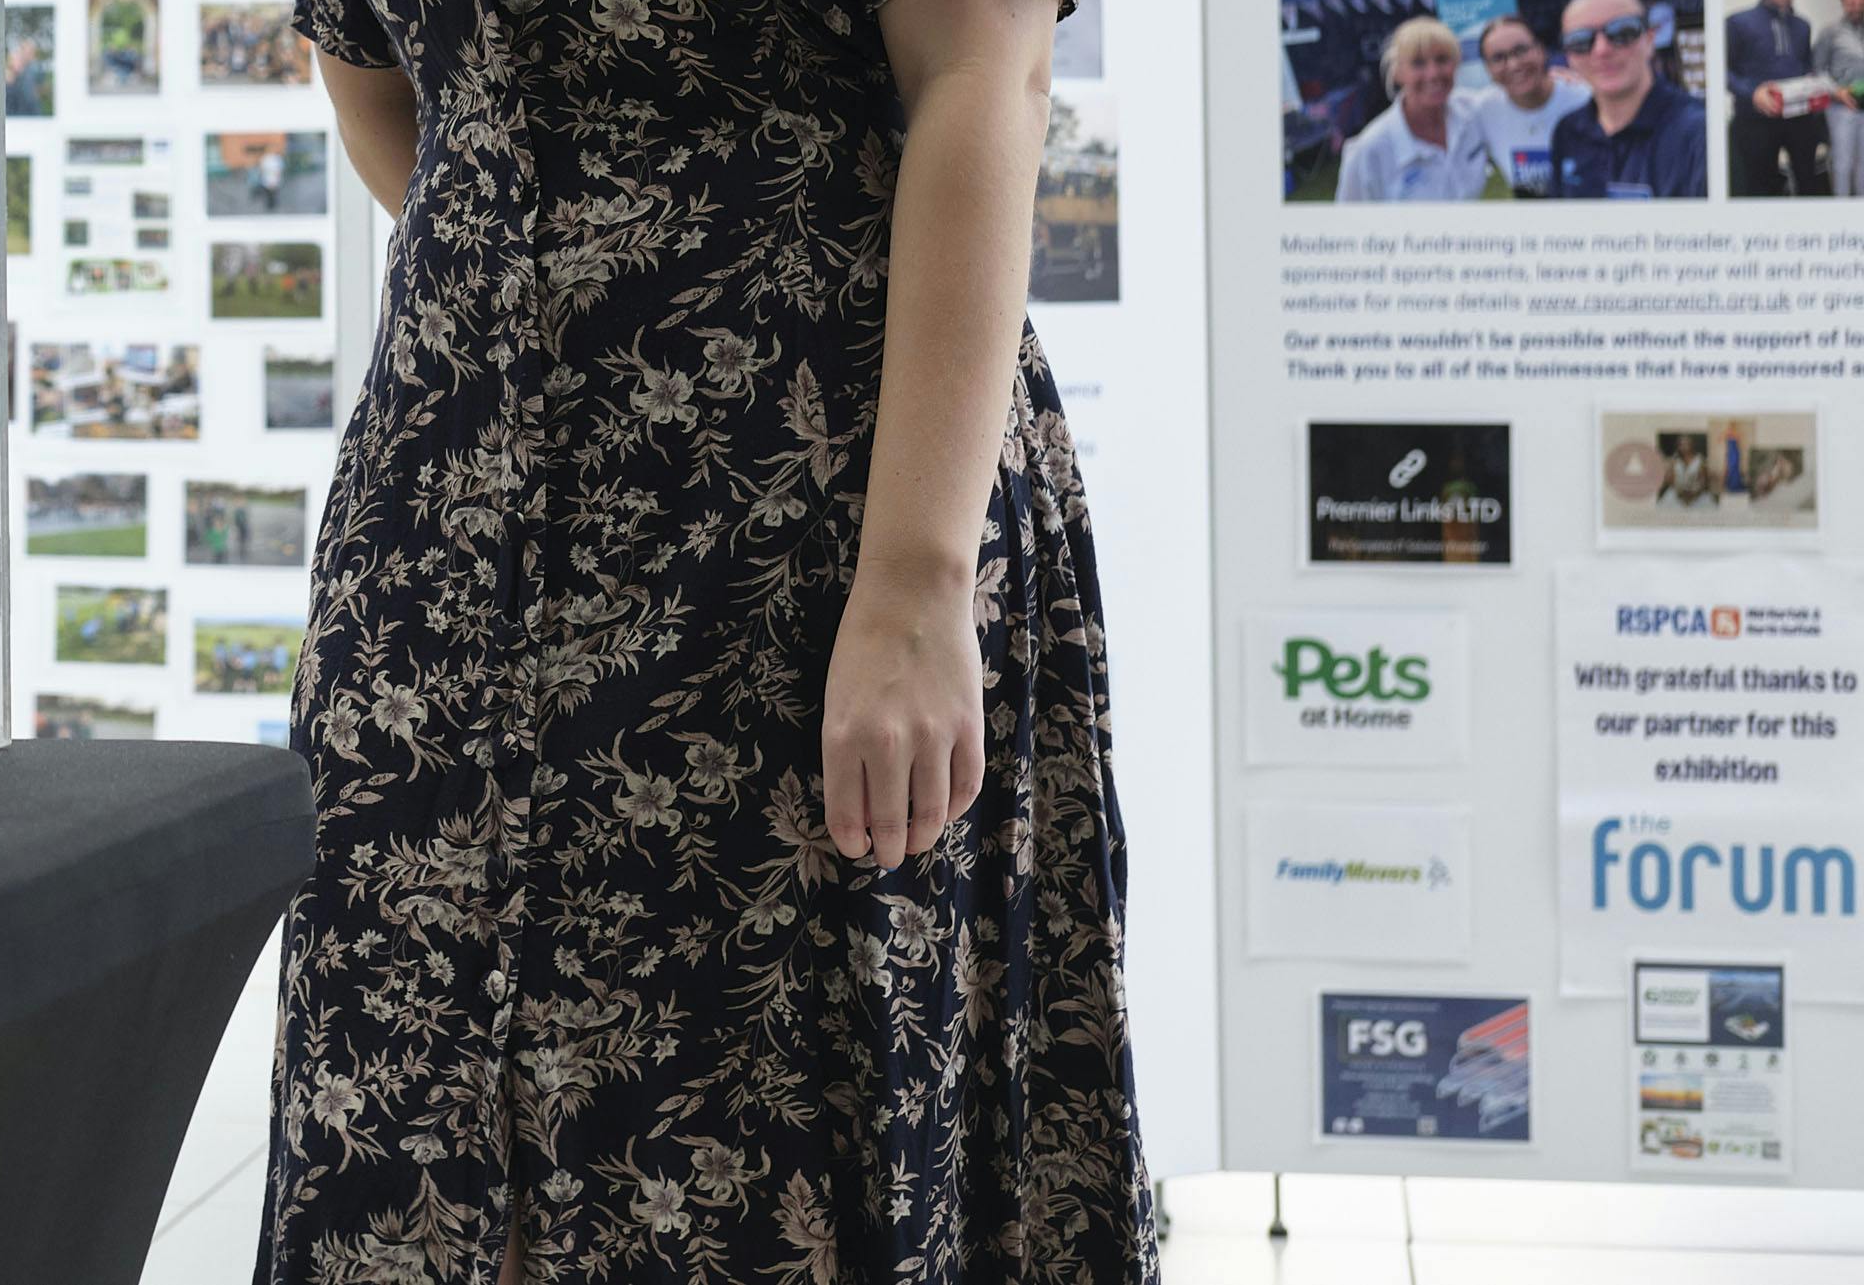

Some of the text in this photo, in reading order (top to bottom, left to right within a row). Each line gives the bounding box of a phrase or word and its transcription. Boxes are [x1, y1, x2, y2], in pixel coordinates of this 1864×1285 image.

[1316, 496, 1397, 523] Premier
[1455, 496, 1502, 524] LTD
[1616, 605, 1707, 637] RSPCA
[1272, 635, 1432, 702] Pets
[1574, 662, 1858, 696] With grateful thanks to
[1300, 706, 1413, 730] at Home
[1595, 711, 1838, 740] our partner for this
[1655, 753, 1779, 784] exhibition
[1628, 813, 1671, 834] the
[1592, 815, 1856, 915] forum
[1347, 1020, 1429, 1057] FSG
